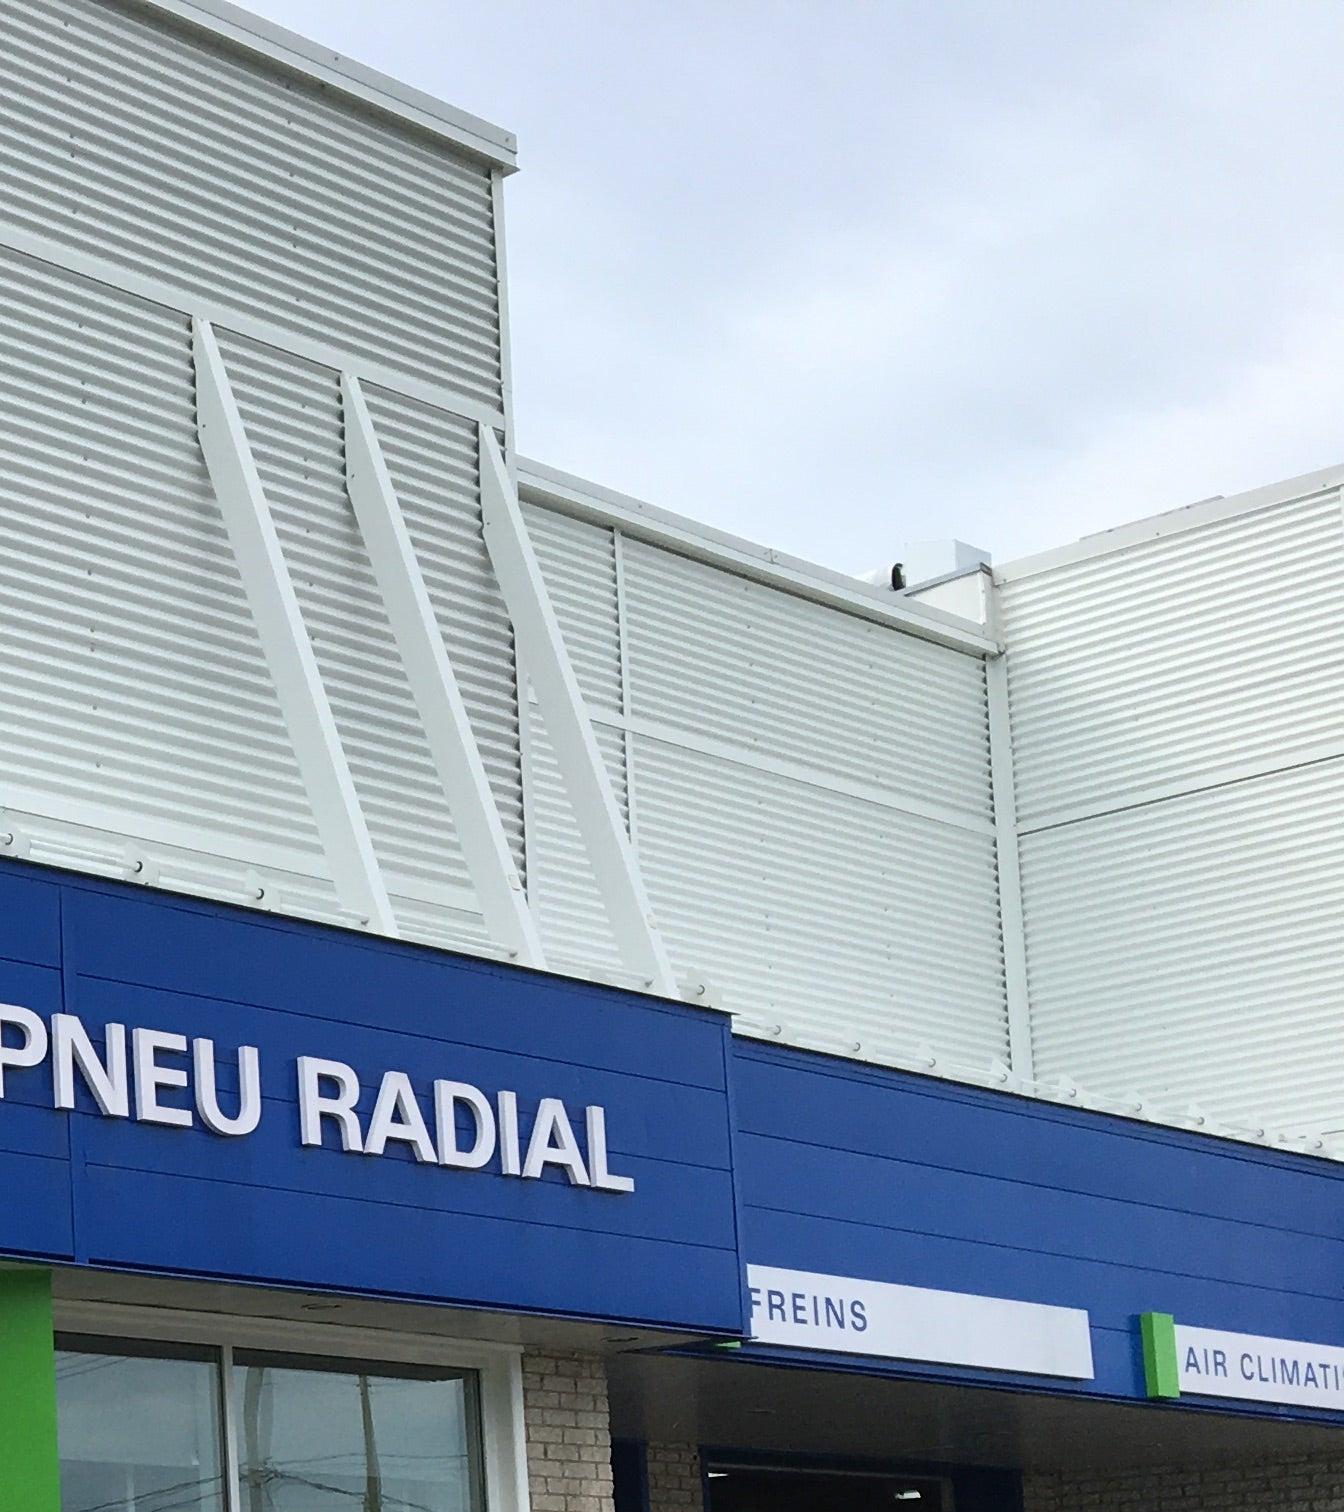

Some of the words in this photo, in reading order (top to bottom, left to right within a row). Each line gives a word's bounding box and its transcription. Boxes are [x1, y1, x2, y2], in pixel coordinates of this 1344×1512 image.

[297, 1055, 634, 1192] RADIAL
[1185, 1346, 1228, 1378] AIR
[1240, 1353, 1344, 1390] CLIMATI
